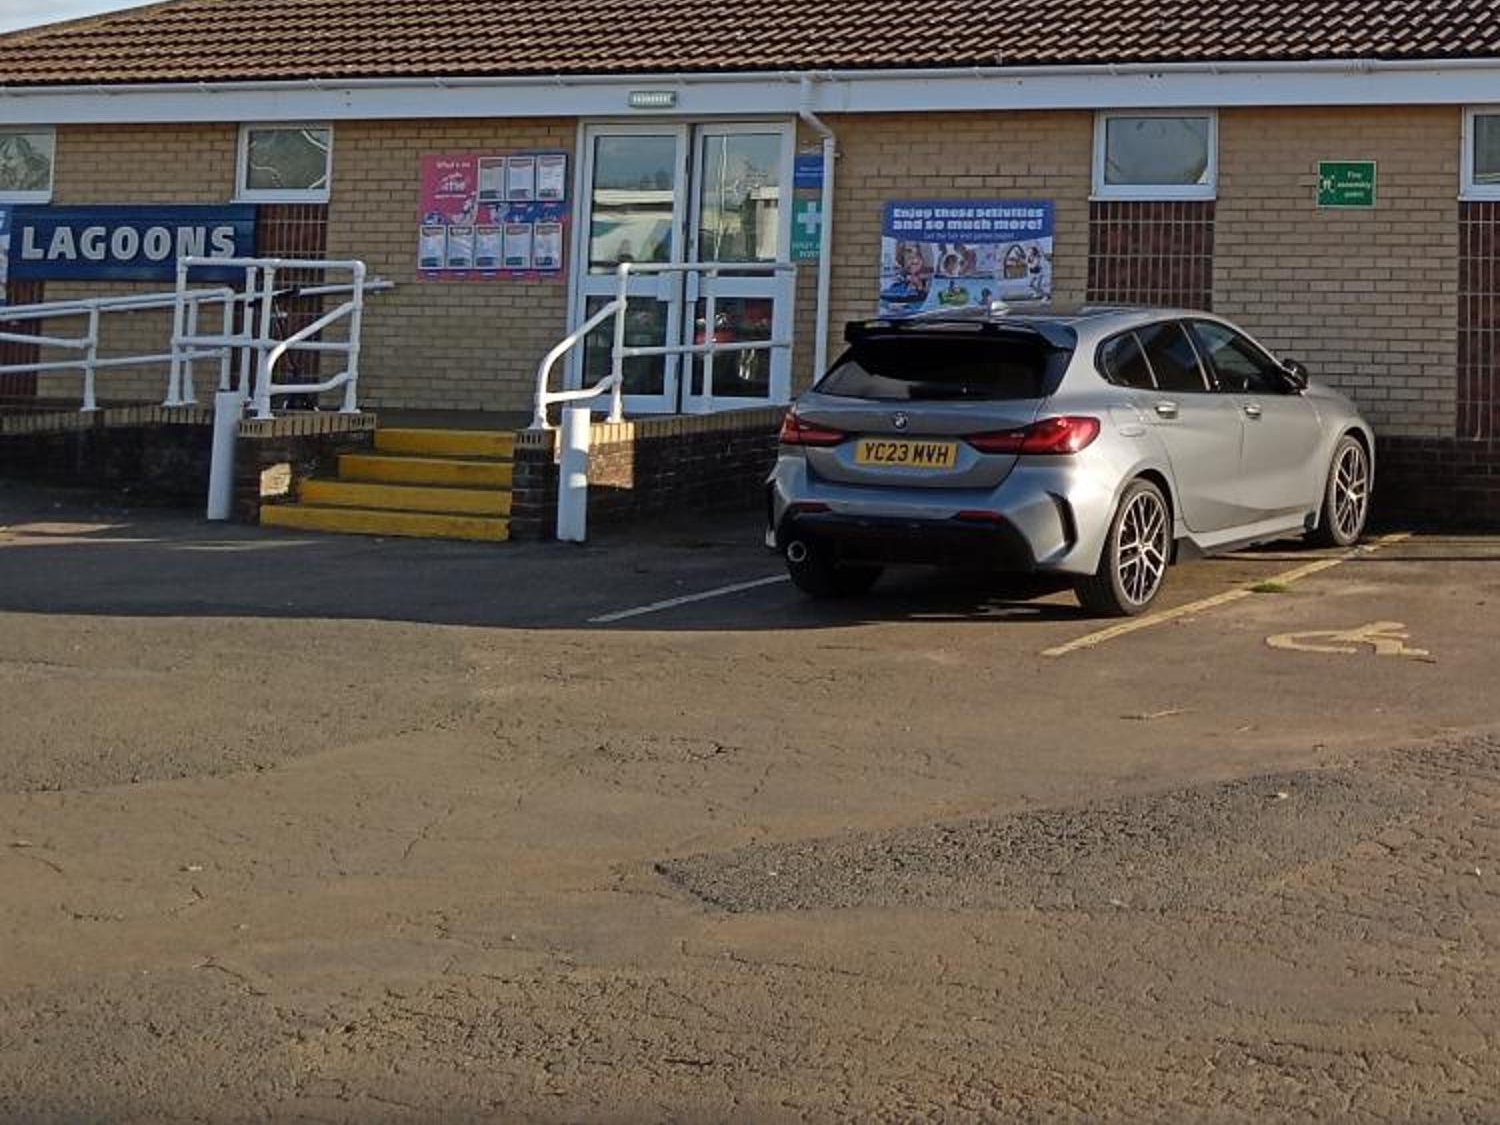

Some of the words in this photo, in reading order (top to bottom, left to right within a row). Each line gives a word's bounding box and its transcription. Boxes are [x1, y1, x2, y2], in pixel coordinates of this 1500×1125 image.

[893, 208, 932, 220] Enjoy
[934, 208, 975, 218] these
[976, 208, 1044, 218] activities
[893, 219, 923, 230] and
[925, 220, 945, 230] so
[947, 219, 992, 230] much
[994, 219, 1043, 230] more!
[21, 226, 235, 261] LAGOONS
[865, 442, 909, 462] YC23
[912, 442, 949, 464] MVH
